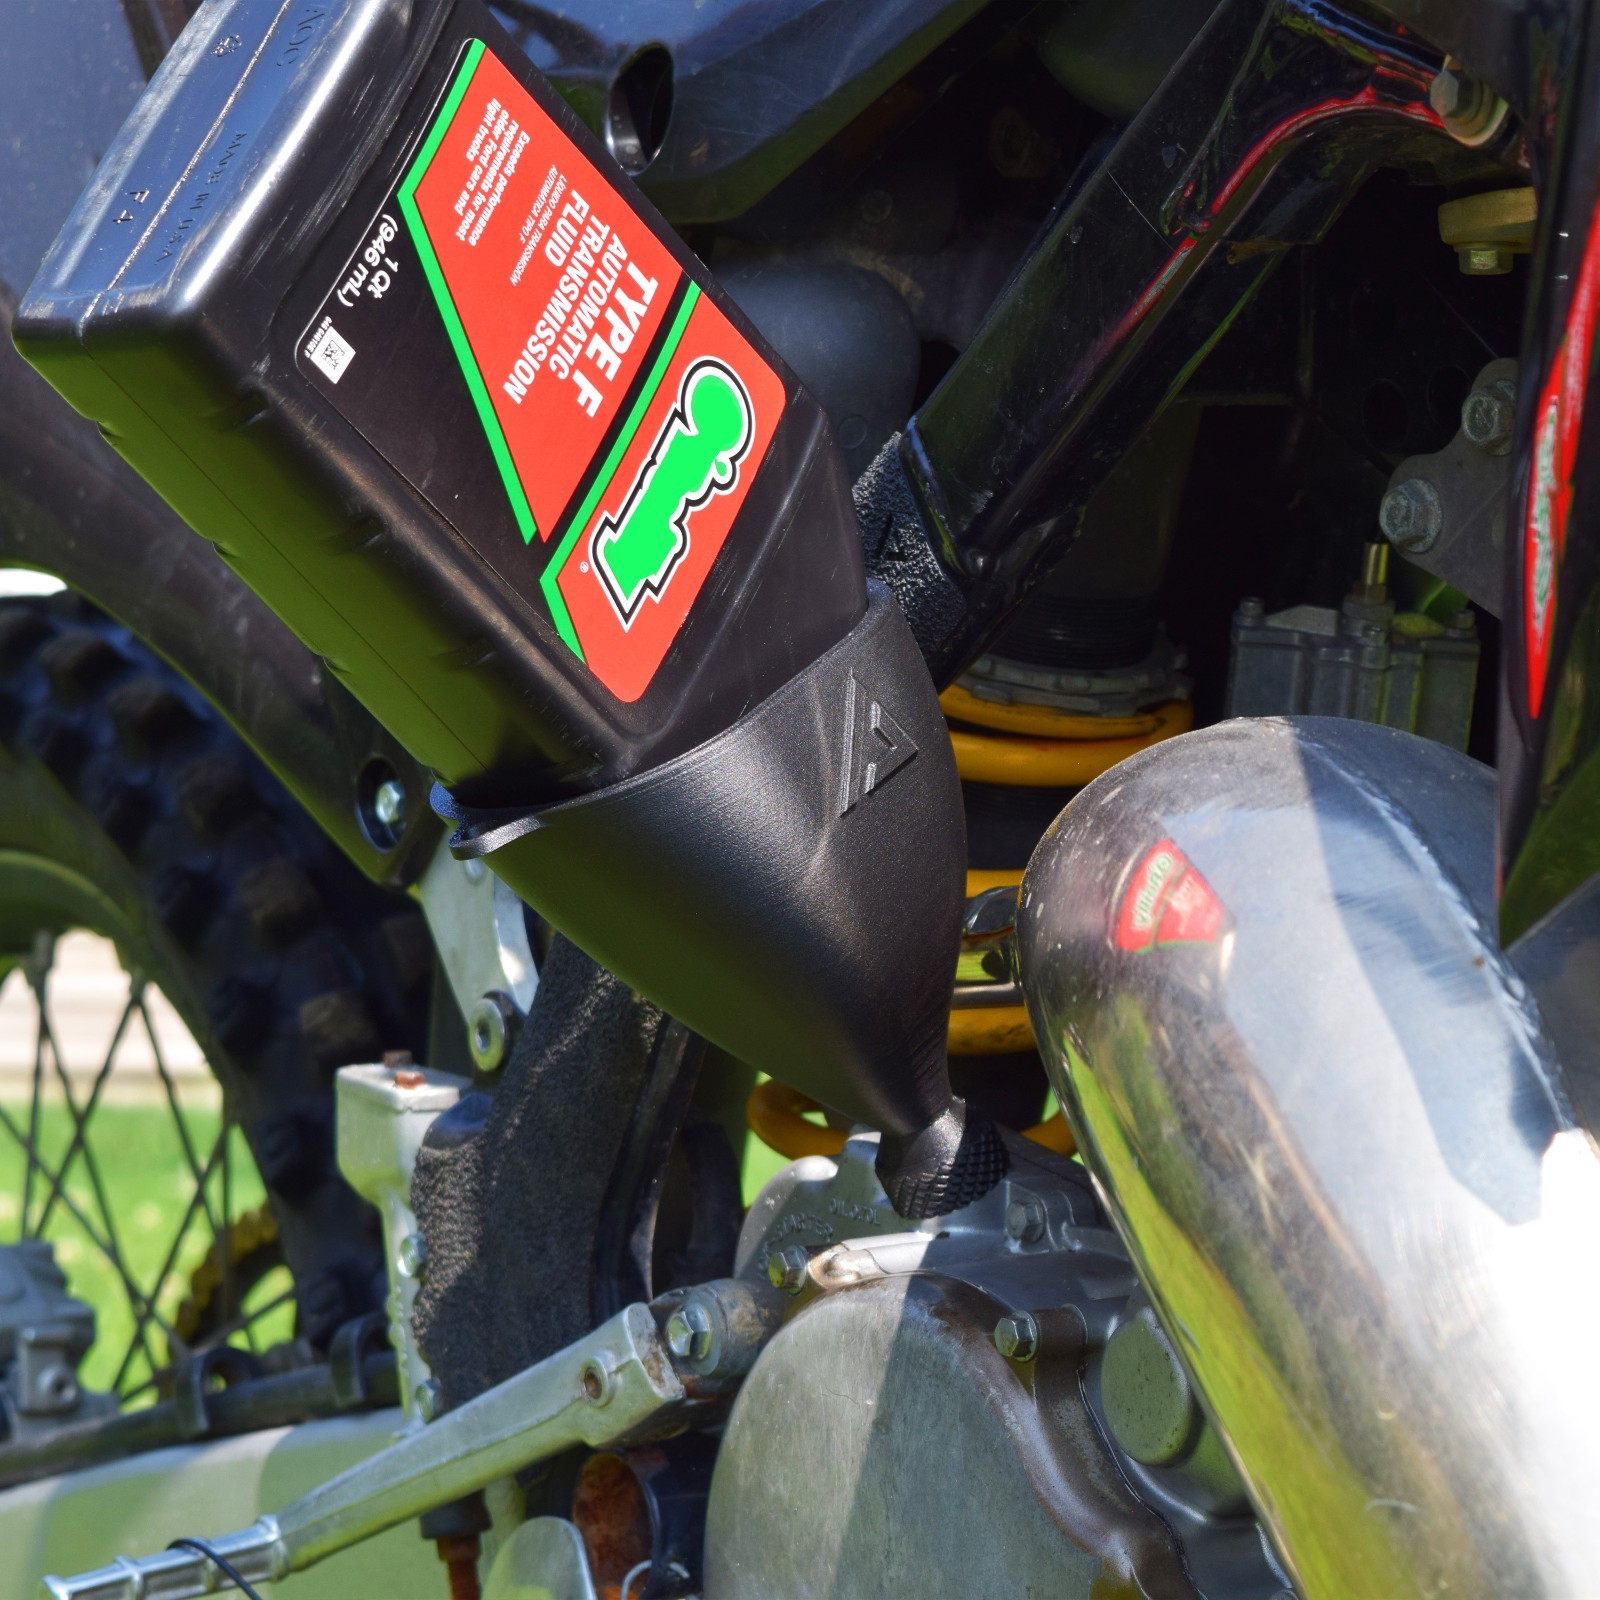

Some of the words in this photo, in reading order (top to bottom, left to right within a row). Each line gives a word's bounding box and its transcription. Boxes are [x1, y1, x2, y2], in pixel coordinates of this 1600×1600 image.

[483, 98, 501, 128] light
[492, 109, 510, 140] older
[465, 124, 489, 162] trucks
[479, 138, 498, 168] Ford
[481, 119, 519, 193] requirements
[504, 131, 530, 177] Exceeds
[466, 165, 483, 192] cars
[454, 189, 470, 216] and
[468, 173, 508, 247] performance
[472, 191, 487, 211] for
[538, 205, 553, 231] PARA
[364, 213, 399, 267] (946
[455, 208, 476, 242] most
[519, 232, 526, 245] F
[521, 215, 536, 237] TIPO
[545, 189, 590, 267] FLUID
[384, 257, 399, 273] 1
[337, 262, 369, 307] mL)
[367, 270, 391, 299] Qt
[503, 215, 611, 404] TRANSMISSION
[549, 233, 628, 380] AUTOMATIC
[584, 261, 659, 381] TYPE
[572, 369, 604, 418] F
